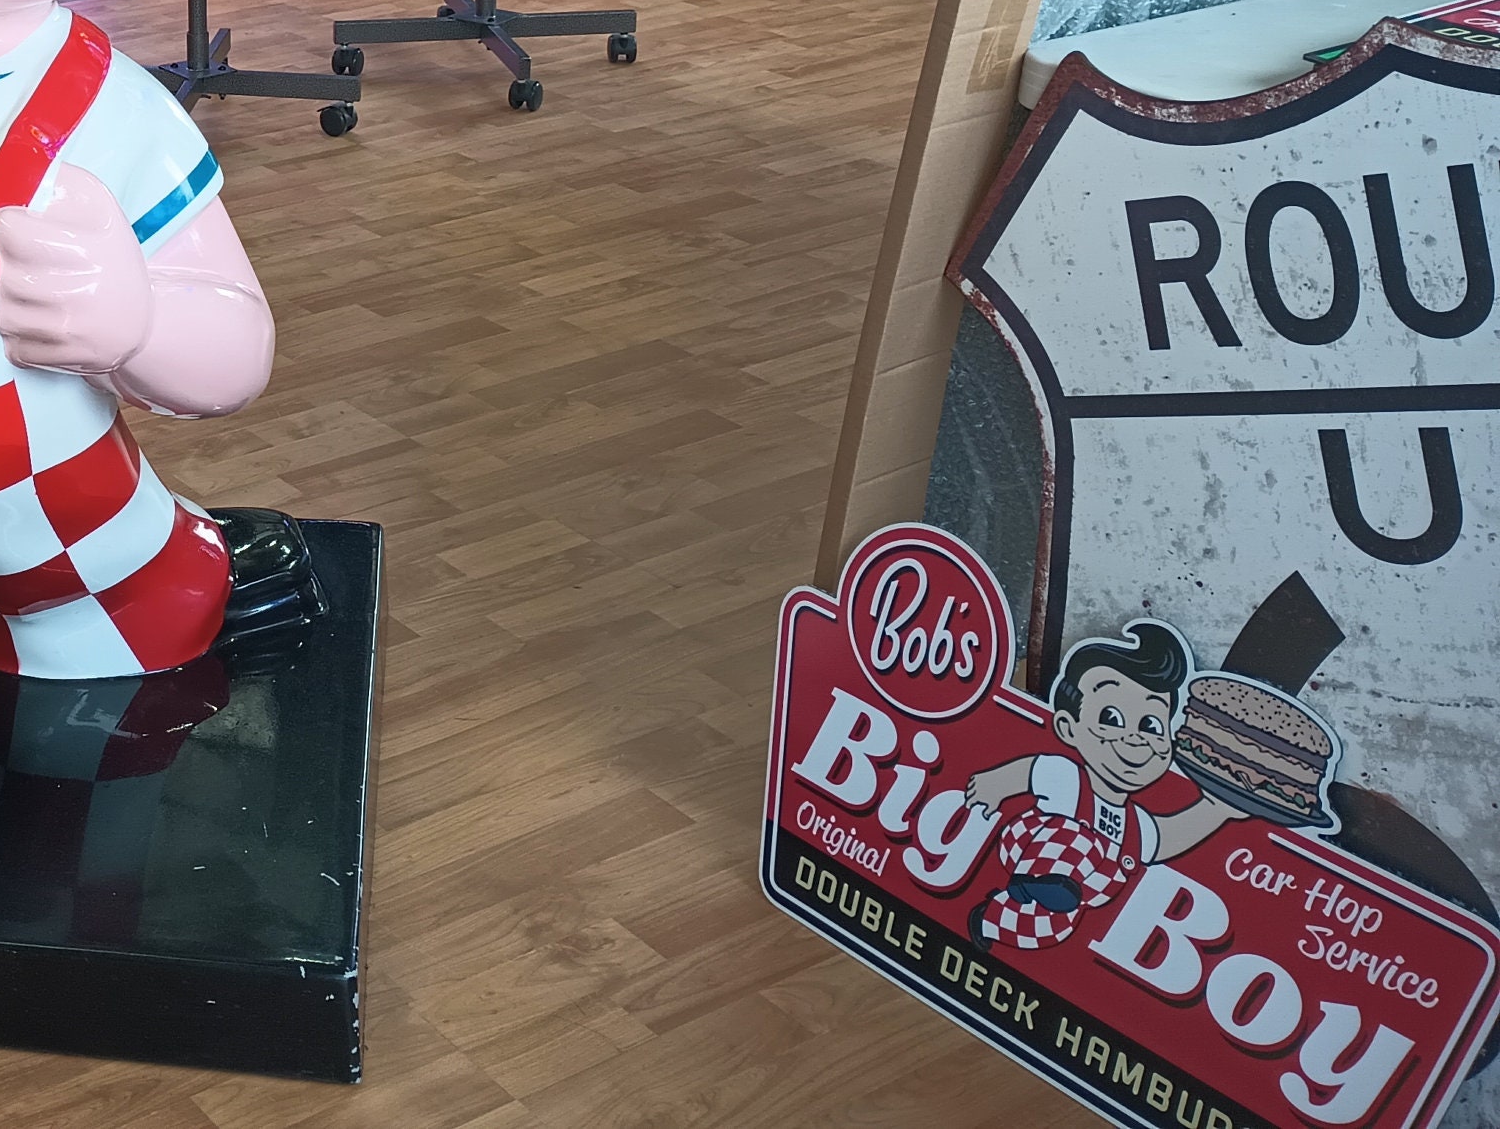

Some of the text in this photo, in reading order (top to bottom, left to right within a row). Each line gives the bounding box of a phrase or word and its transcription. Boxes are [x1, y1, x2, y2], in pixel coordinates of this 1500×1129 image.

[1125, 163, 1498, 352] ROU
[869, 557, 980, 679] Bob's
[790, 685, 1005, 889] Big
[794, 799, 892, 879] Original
[1098, 819, 1124, 841] BOY
[1099, 804, 1122, 828] BIG
[793, 854, 927, 962] DOUBLE
[938, 947, 1040, 1032] DECK
[1224, 847, 1386, 938] Car Hop
[1086, 863, 1419, 1126] Boy
[1297, 923, 1441, 1010] Service
